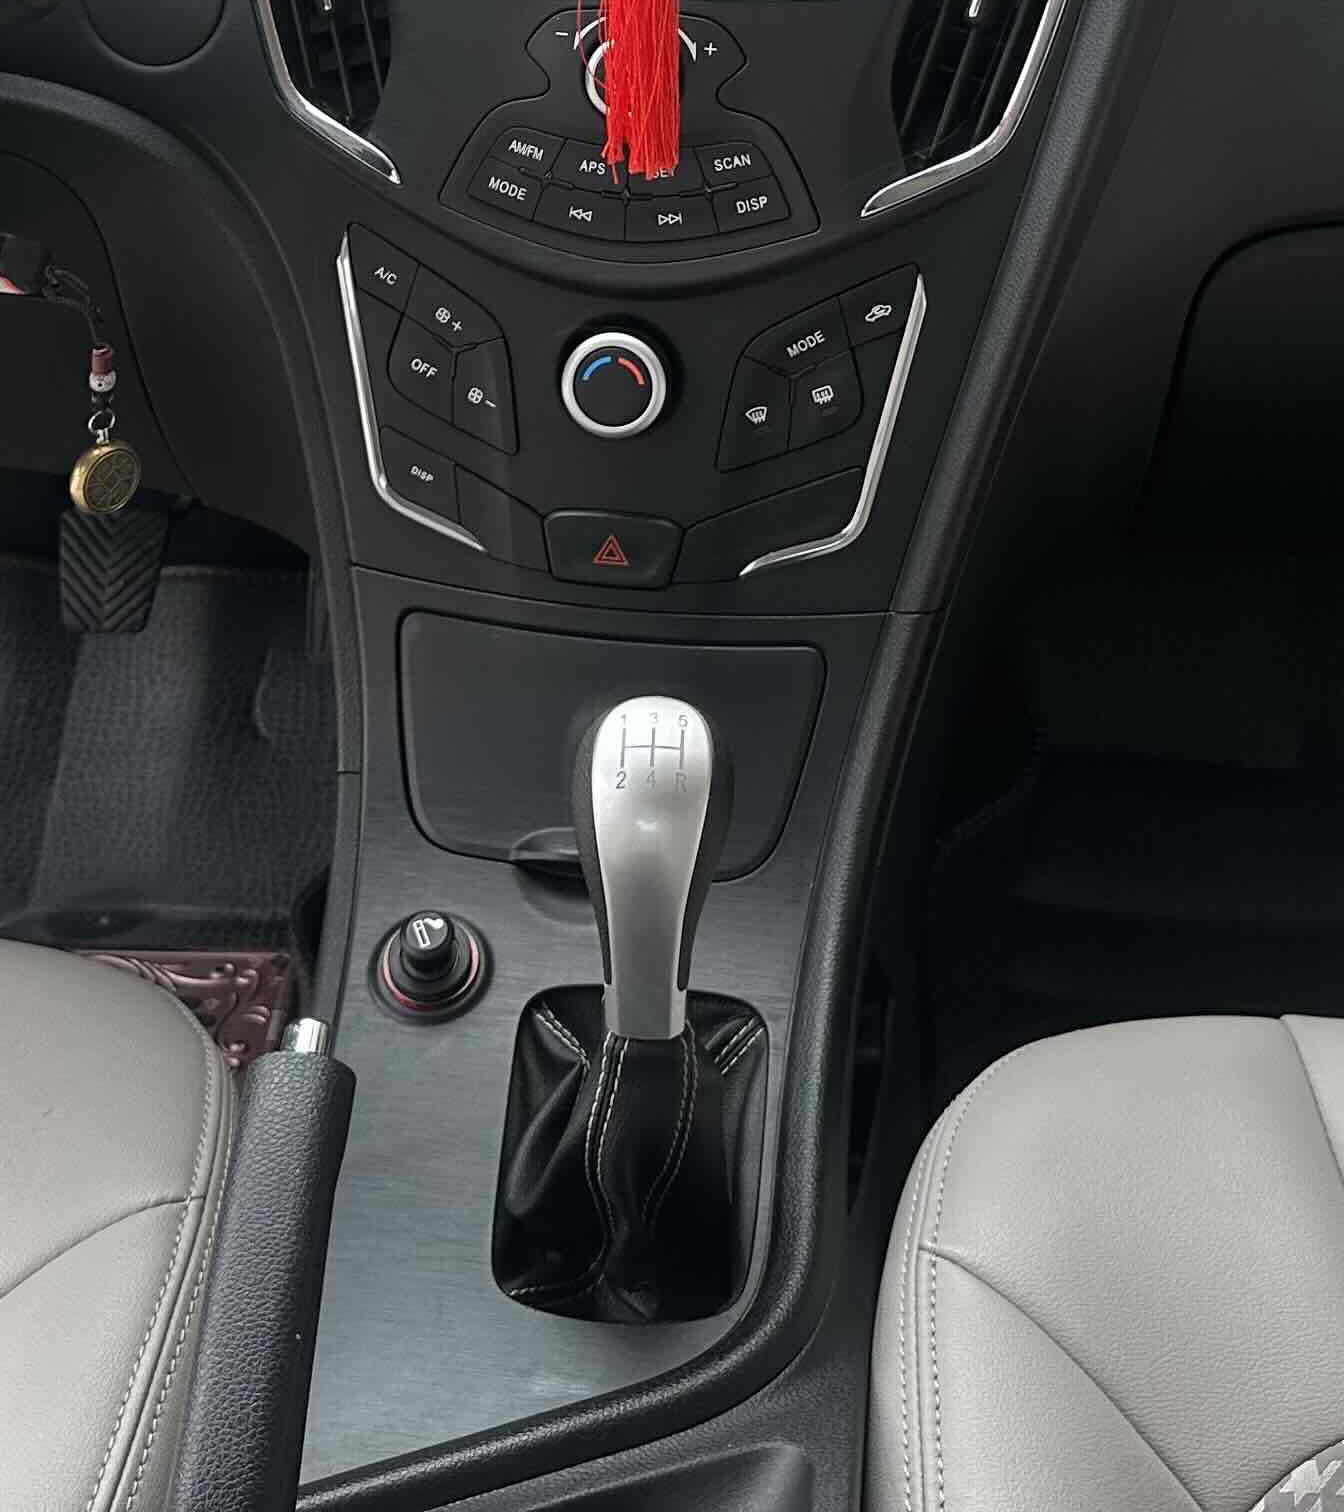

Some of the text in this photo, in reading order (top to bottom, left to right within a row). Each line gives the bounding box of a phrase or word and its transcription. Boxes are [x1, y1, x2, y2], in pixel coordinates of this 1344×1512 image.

[508, 138, 545, 161] AM/FM
[579, 159, 607, 176] APS
[713, 153, 752, 172] SCAN
[487, 176, 528, 201] MODE
[735, 194, 769, 214] DISP
[374, 266, 398, 286] A/C
[786, 330, 826, 358] MODE
[410, 358, 438, 378] OFF
[410, 465, 434, 482] DISP
[619, 713, 627, 726] 1
[649, 711, 659, 724] 3
[678, 713, 689, 727] 5
[615, 770, 627, 789] 2
[645, 769, 657, 790] 4
[675, 771, 687, 792] R
